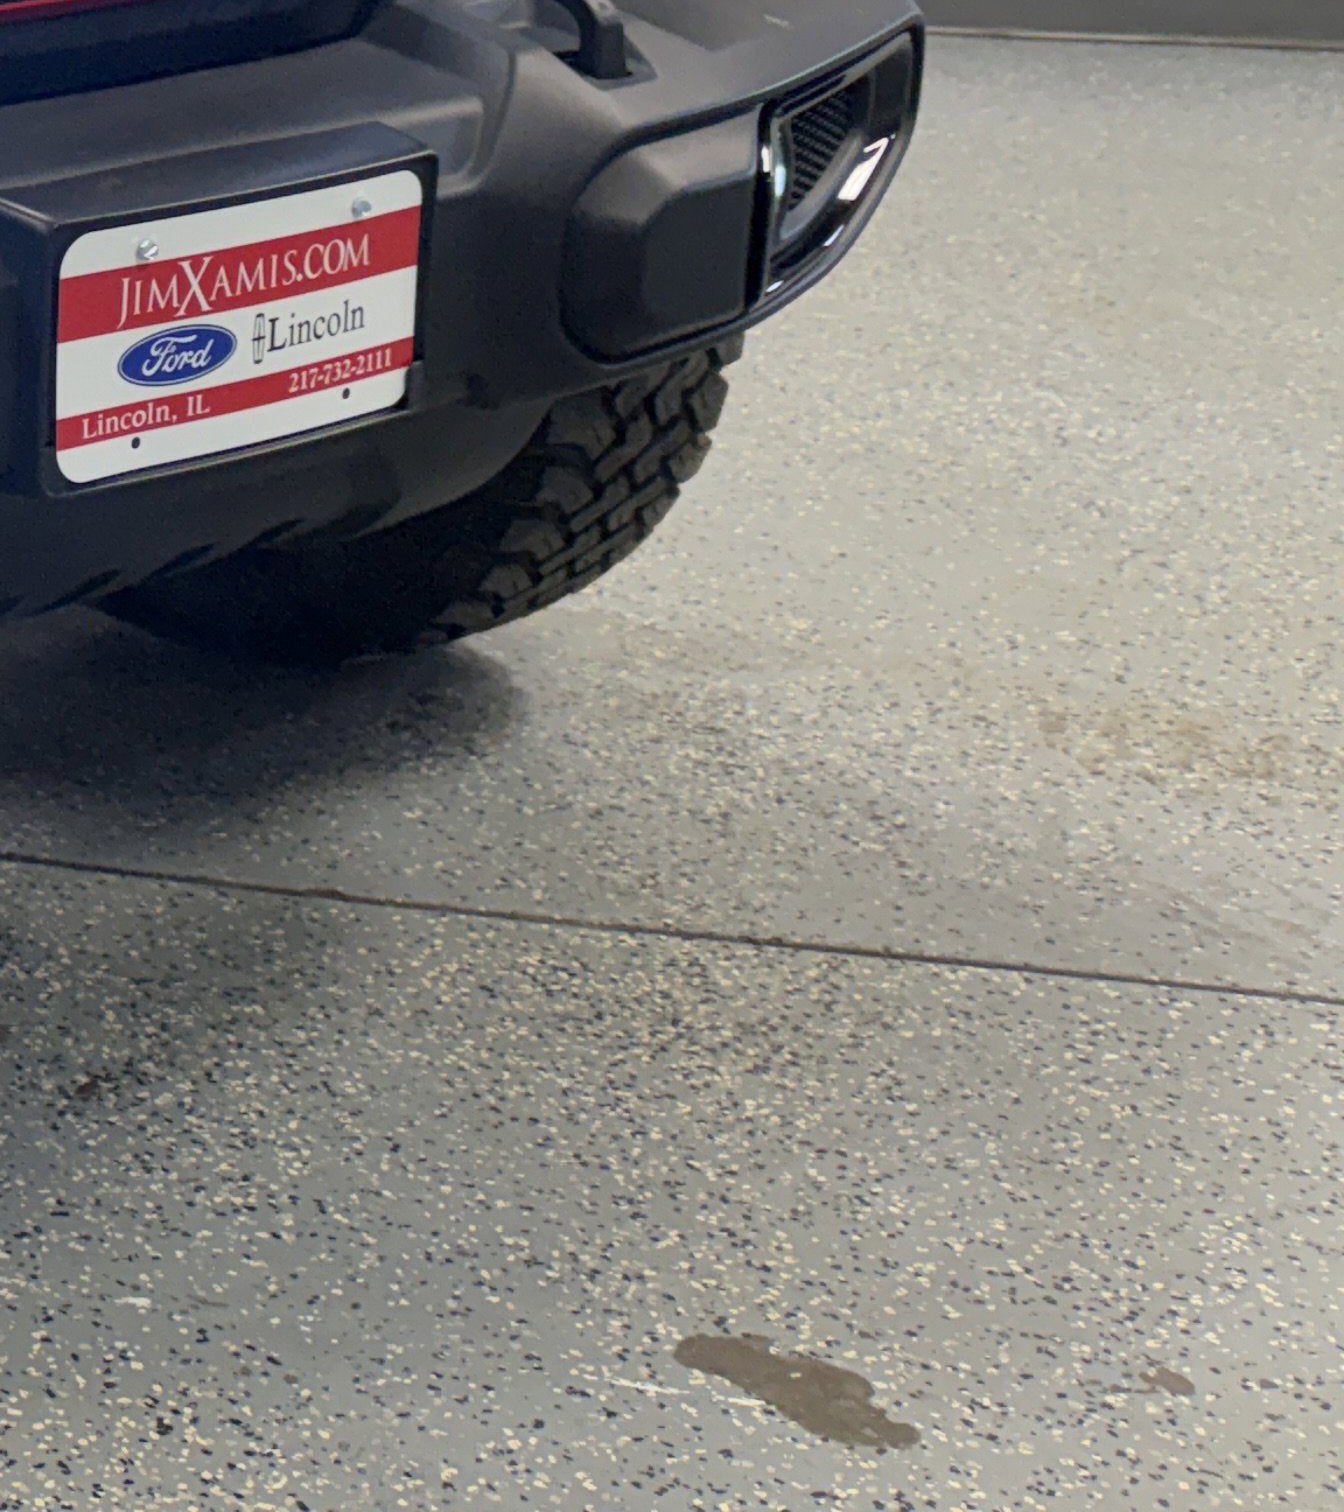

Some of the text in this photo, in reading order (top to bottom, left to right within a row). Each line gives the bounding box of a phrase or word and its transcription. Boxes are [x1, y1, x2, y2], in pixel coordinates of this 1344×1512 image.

[117, 234, 371, 330] JIMXAMIS.COM
[267, 300, 366, 352] Lincoln
[141, 335, 213, 377] Ford
[288, 348, 393, 394] 217-732-2111
[82, 396, 210, 440] Lincoln, IL
